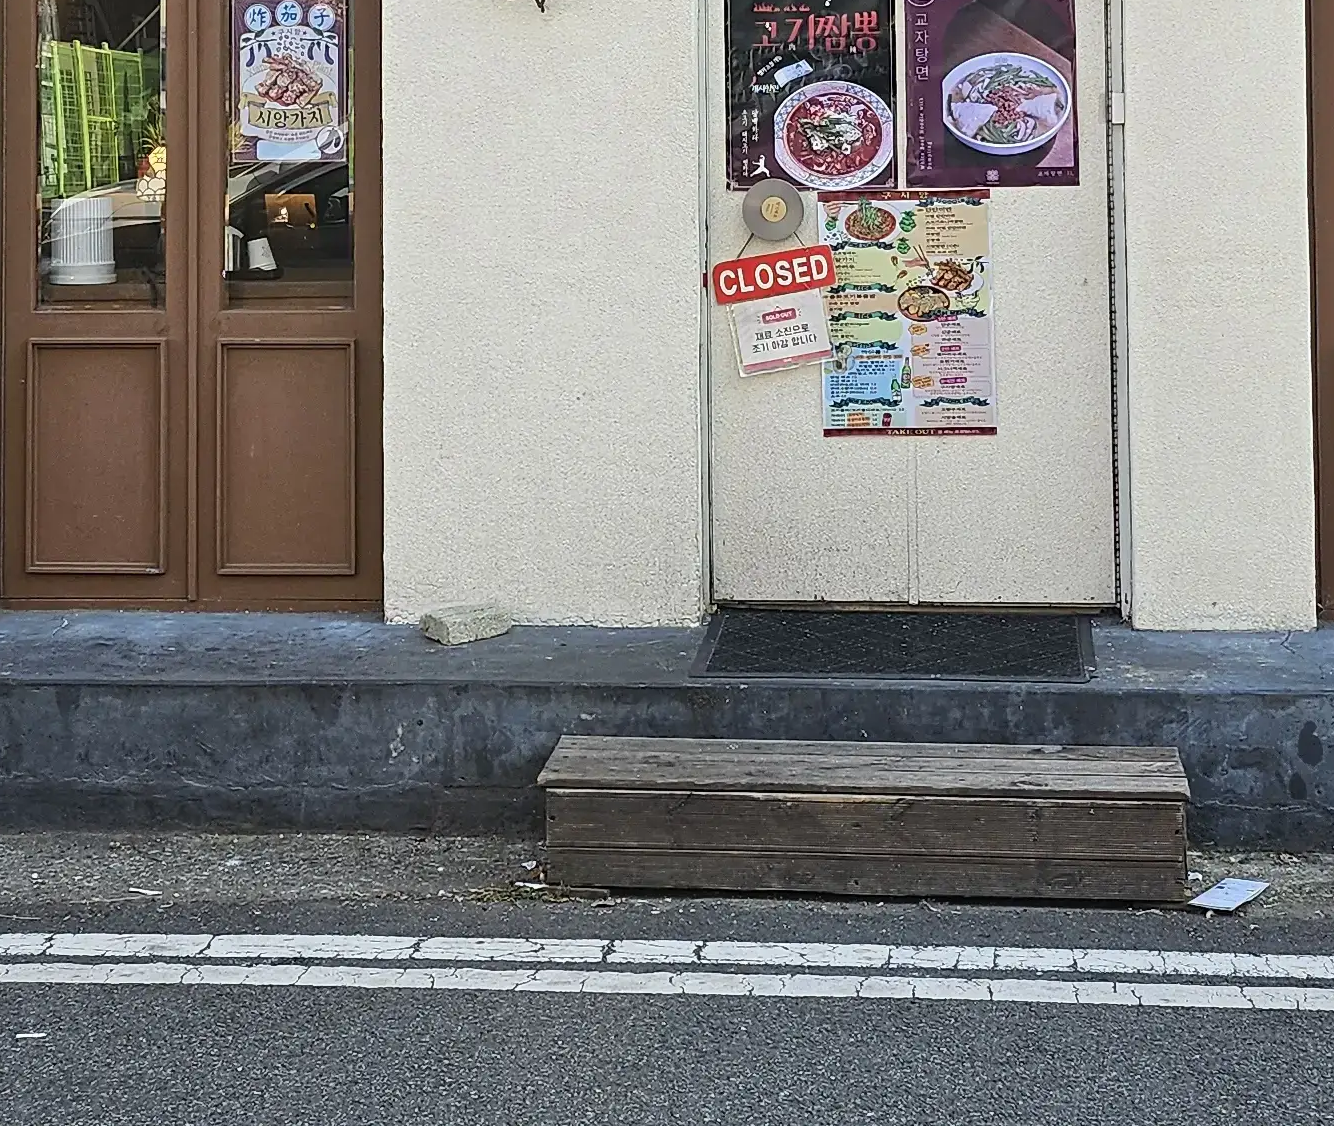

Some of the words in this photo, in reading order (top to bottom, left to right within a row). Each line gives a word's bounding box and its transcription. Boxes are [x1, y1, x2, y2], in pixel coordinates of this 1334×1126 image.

[752, 10, 881, 52] 고기짬뽕
[914, 12, 930, 82] 교자탕면
[255, 107, 324, 128] 시앙가지
[719, 254, 828, 296] CLOSED
[780, 311, 793, 319] OUT
[755, 330, 773, 342] 재료
[775, 323, 810, 338] 소진으로
[752, 343, 770, 354] 조기
[771, 338, 789, 349] 마감
[792, 333, 818, 347] 합니다
